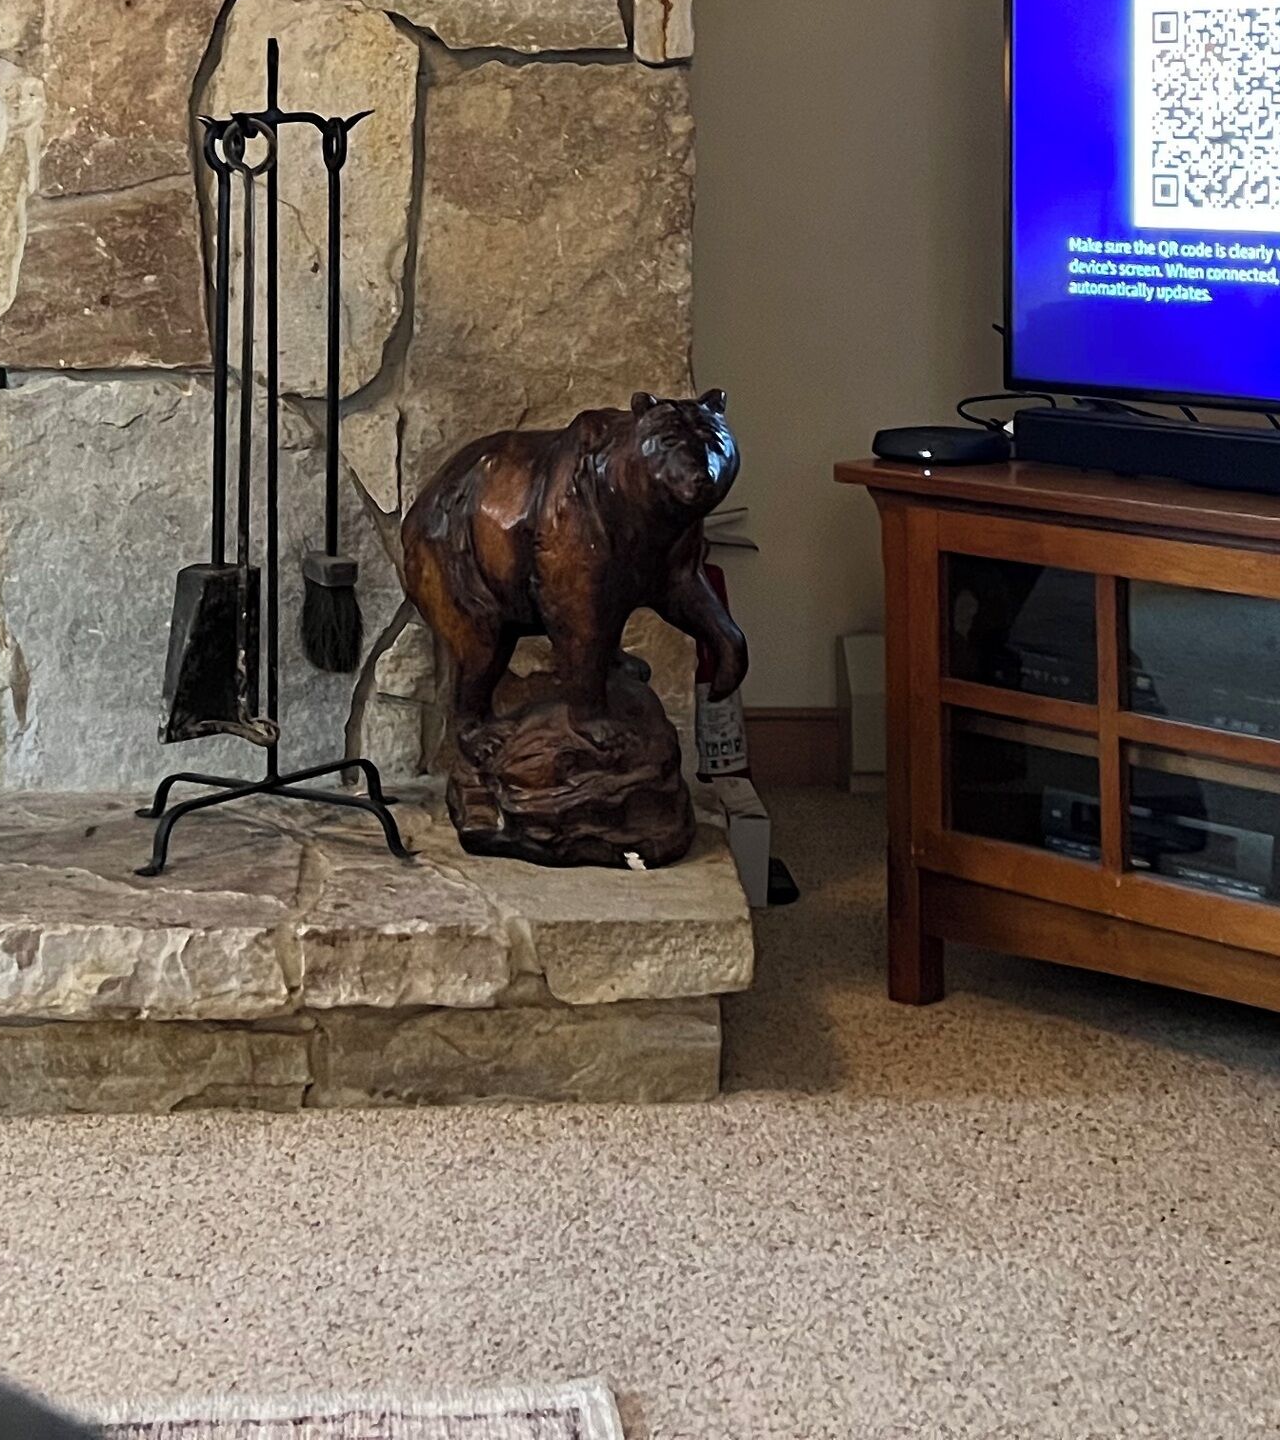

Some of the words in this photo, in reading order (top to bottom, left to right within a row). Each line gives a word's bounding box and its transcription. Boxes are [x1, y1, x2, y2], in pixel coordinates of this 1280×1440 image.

[1069, 237, 1102, 254] Make
[1104, 240, 1132, 255] sure
[1133, 240, 1156, 256] the
[1158, 241, 1179, 258] QR
[1180, 242, 1212, 259] code
[1216, 243, 1226, 259] is
[1228, 243, 1274, 263] clearly
[1069, 258, 1118, 276] device's
[1119, 263, 1163, 278] screen.
[1165, 263, 1204, 280] When
[1206, 266, 1279, 286] connected,
[1069, 280, 1154, 301] automatically
[1156, 284, 1213, 303] updates.
